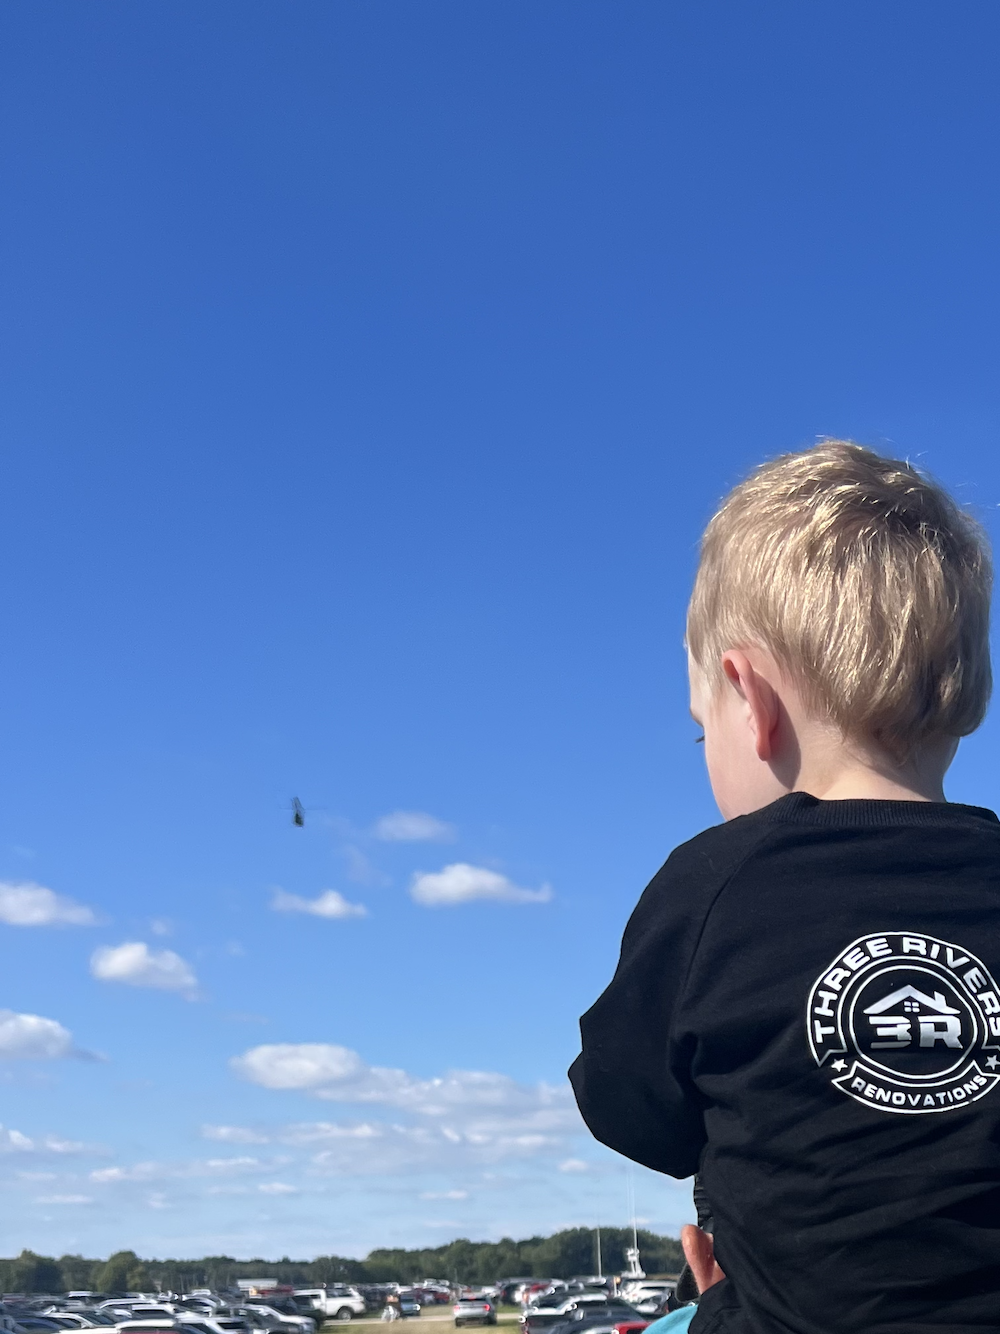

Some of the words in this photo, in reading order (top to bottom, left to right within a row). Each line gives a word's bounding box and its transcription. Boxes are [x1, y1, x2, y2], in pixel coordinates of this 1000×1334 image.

[814, 938, 893, 1043] THREE
[869, 1015, 963, 1049] 3R
[851, 1074, 988, 1106] RENOVATIONS
